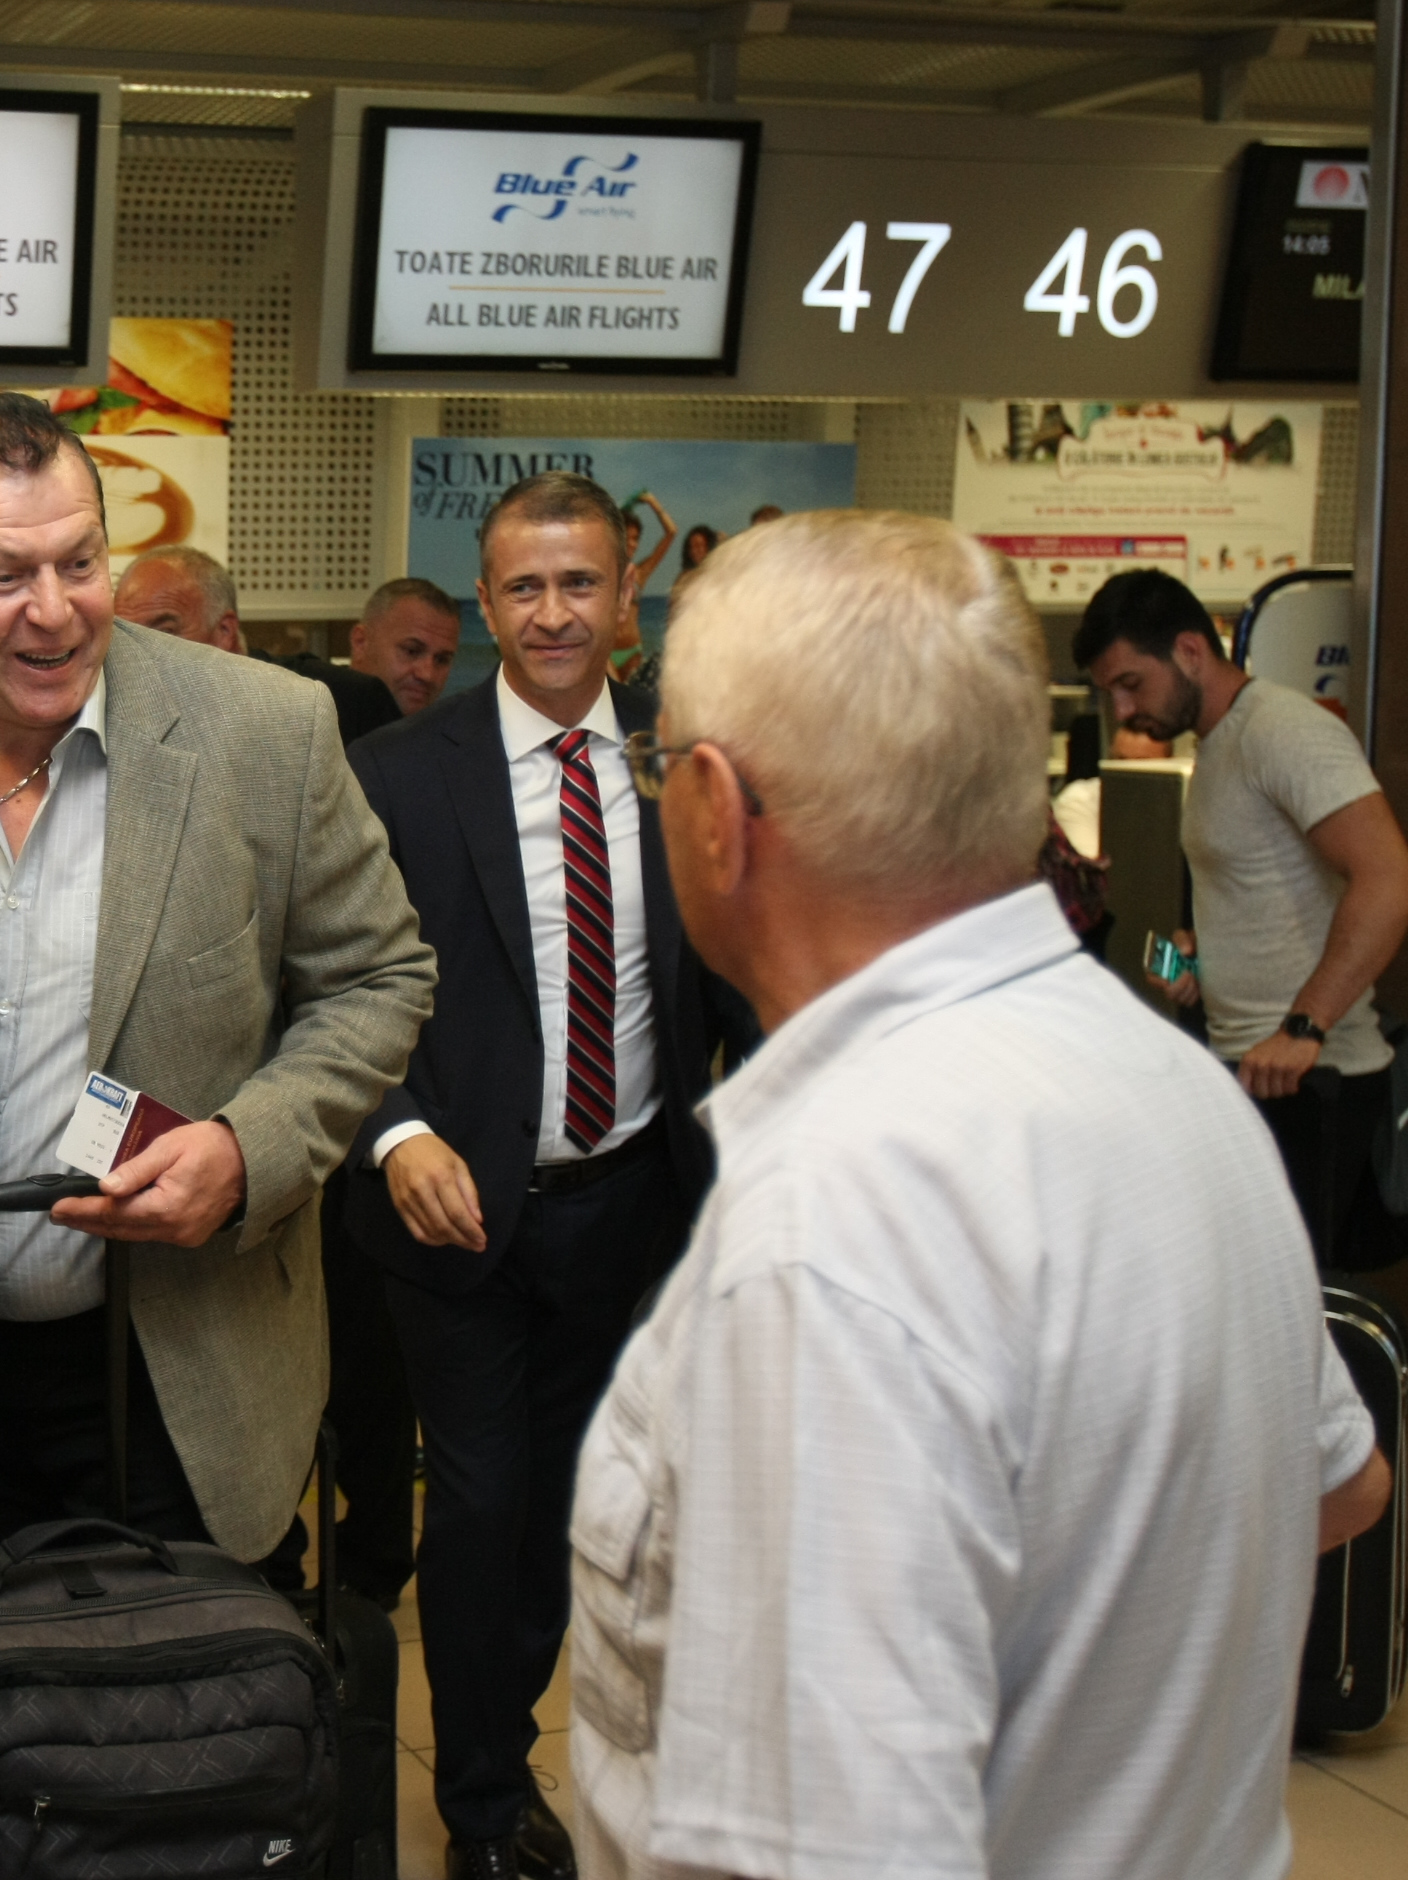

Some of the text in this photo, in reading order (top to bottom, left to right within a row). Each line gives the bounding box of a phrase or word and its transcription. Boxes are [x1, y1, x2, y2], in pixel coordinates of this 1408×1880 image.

[494, 173, 637, 197] Blue Air
[16, 240, 59, 264] AIR
[395, 250, 719, 281] TOATE ZBORURILE BLUE AIR
[803, 222, 951, 333] 47
[1024, 228, 1162, 338] 46
[426, 303, 680, 331] ALL BLUE AIR FLIGHTS
[268, 1839, 292, 1854] NIKE
